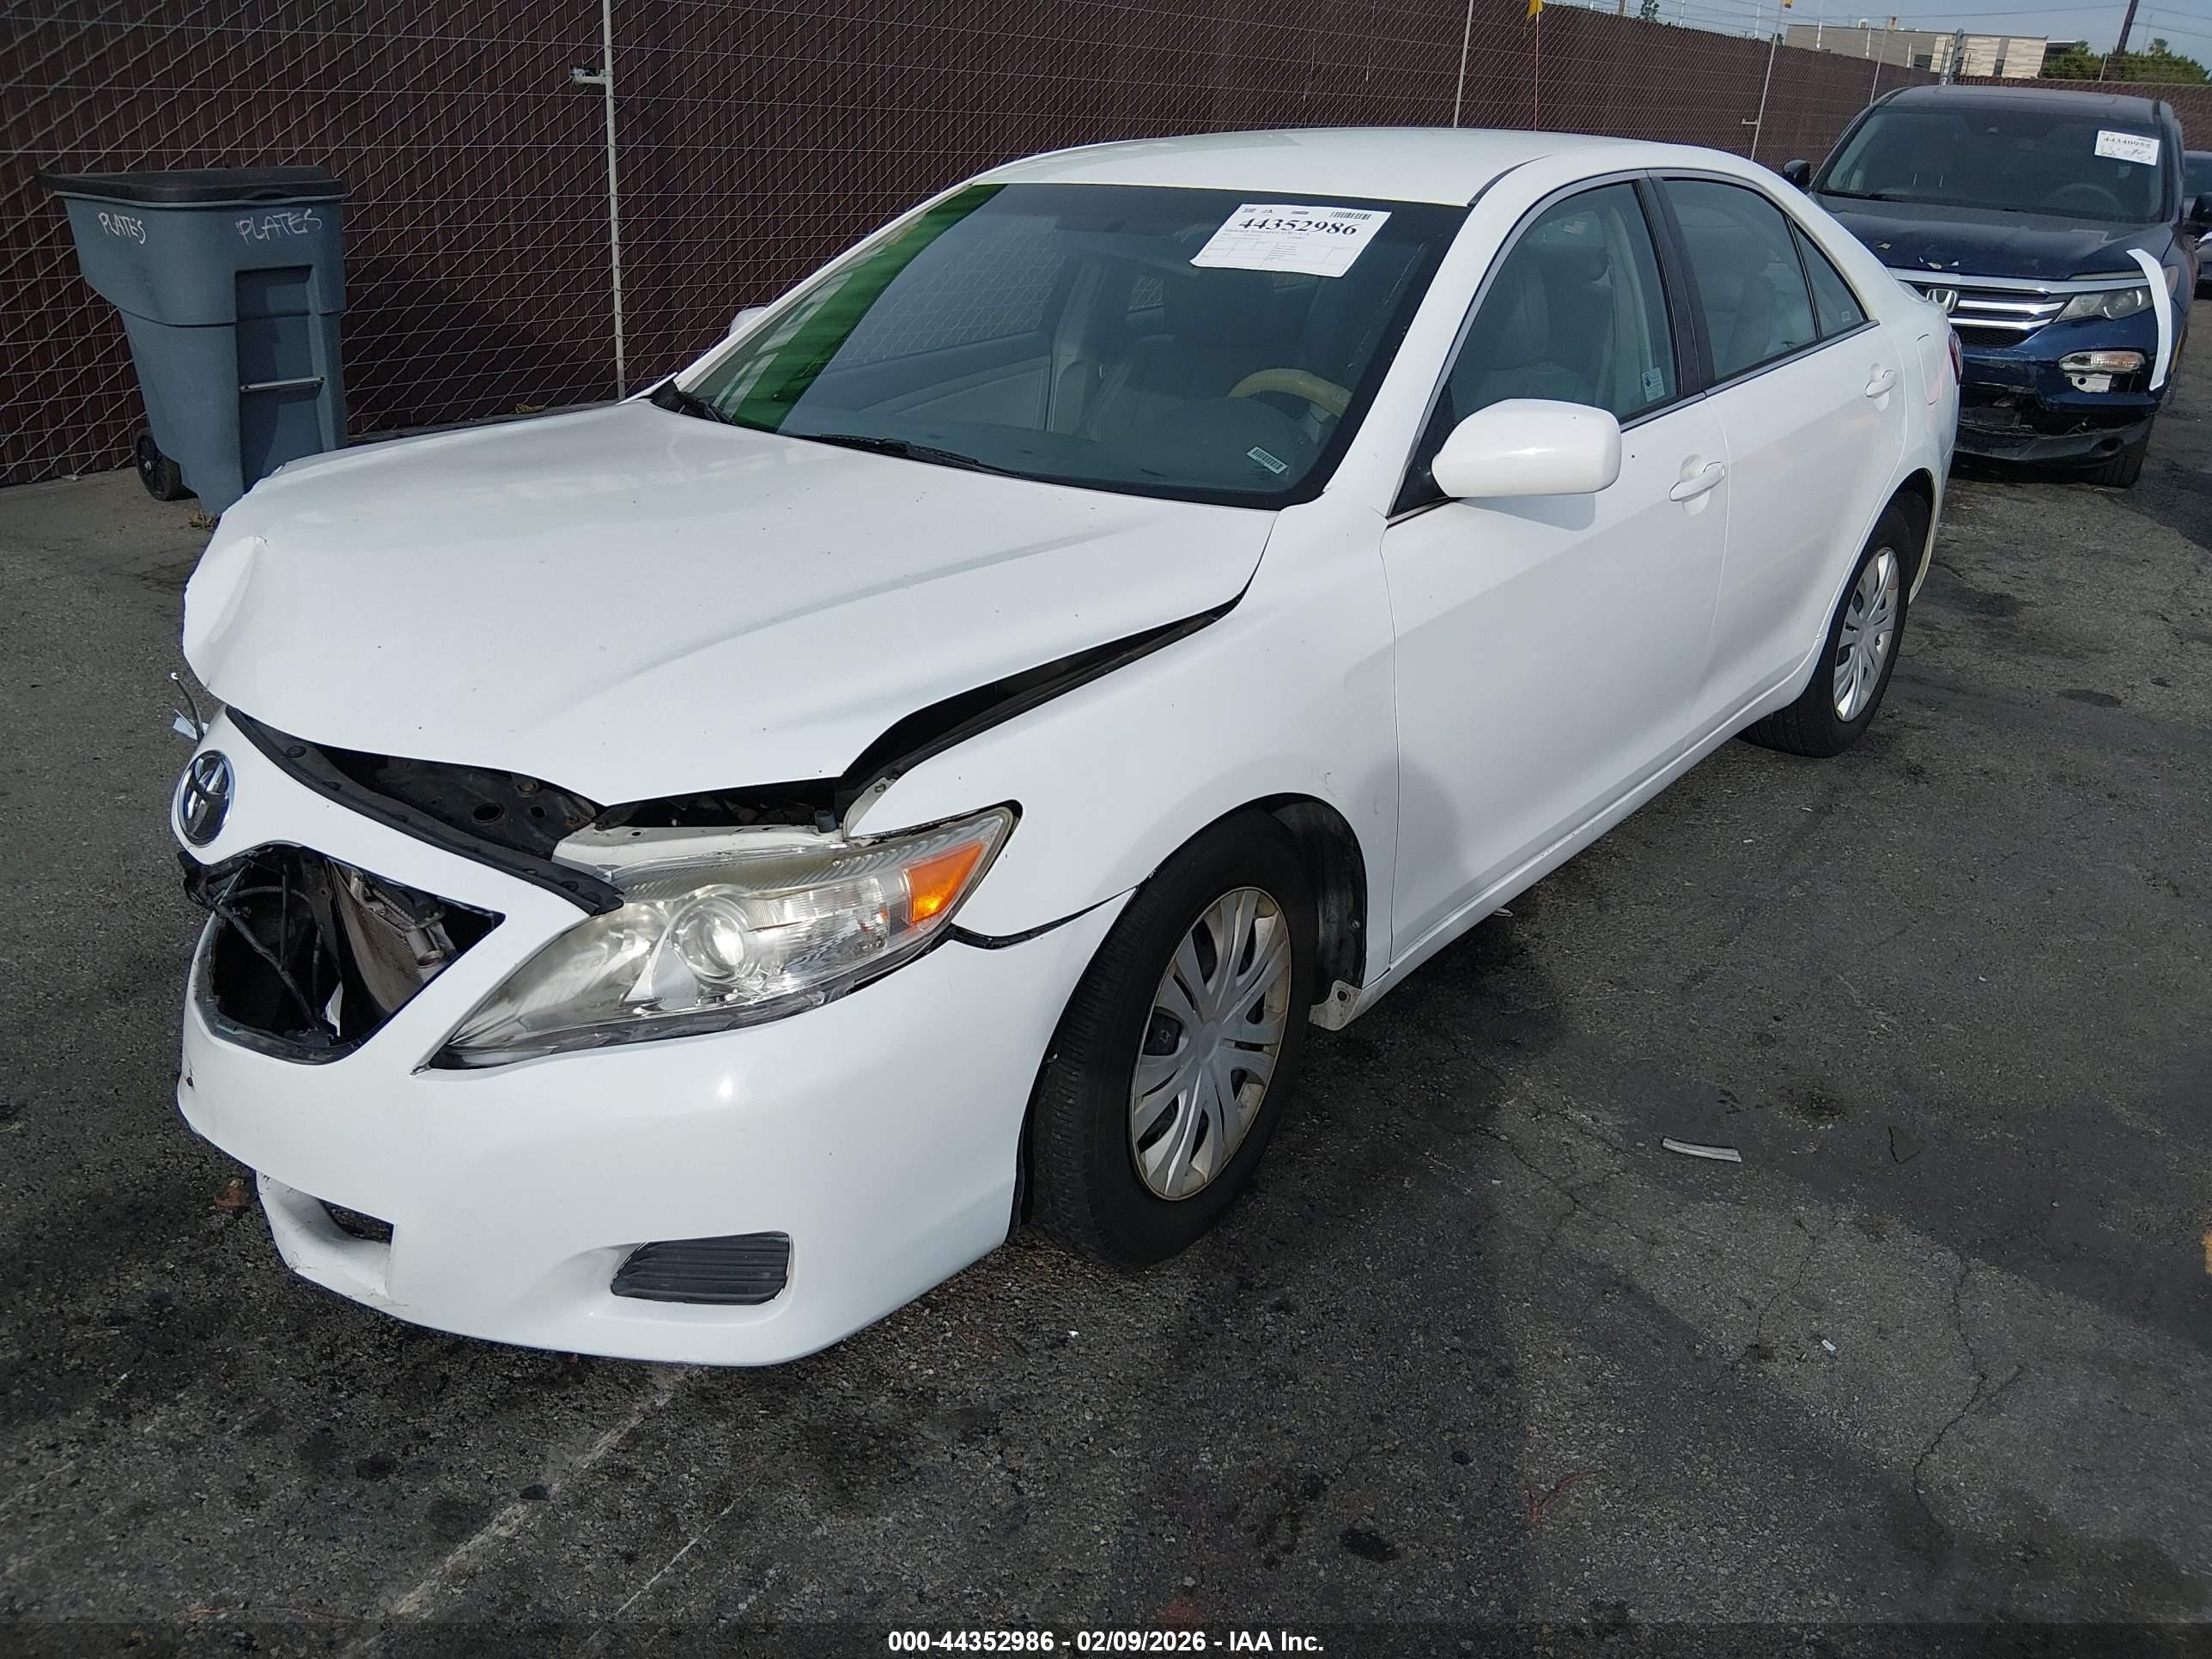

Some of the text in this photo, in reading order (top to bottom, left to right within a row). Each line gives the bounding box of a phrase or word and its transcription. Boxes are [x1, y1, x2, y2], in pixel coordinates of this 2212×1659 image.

[98, 212, 146, 245] PLATES
[235, 208, 323, 246] PLATES
[1238, 217, 1360, 235] 44352986
